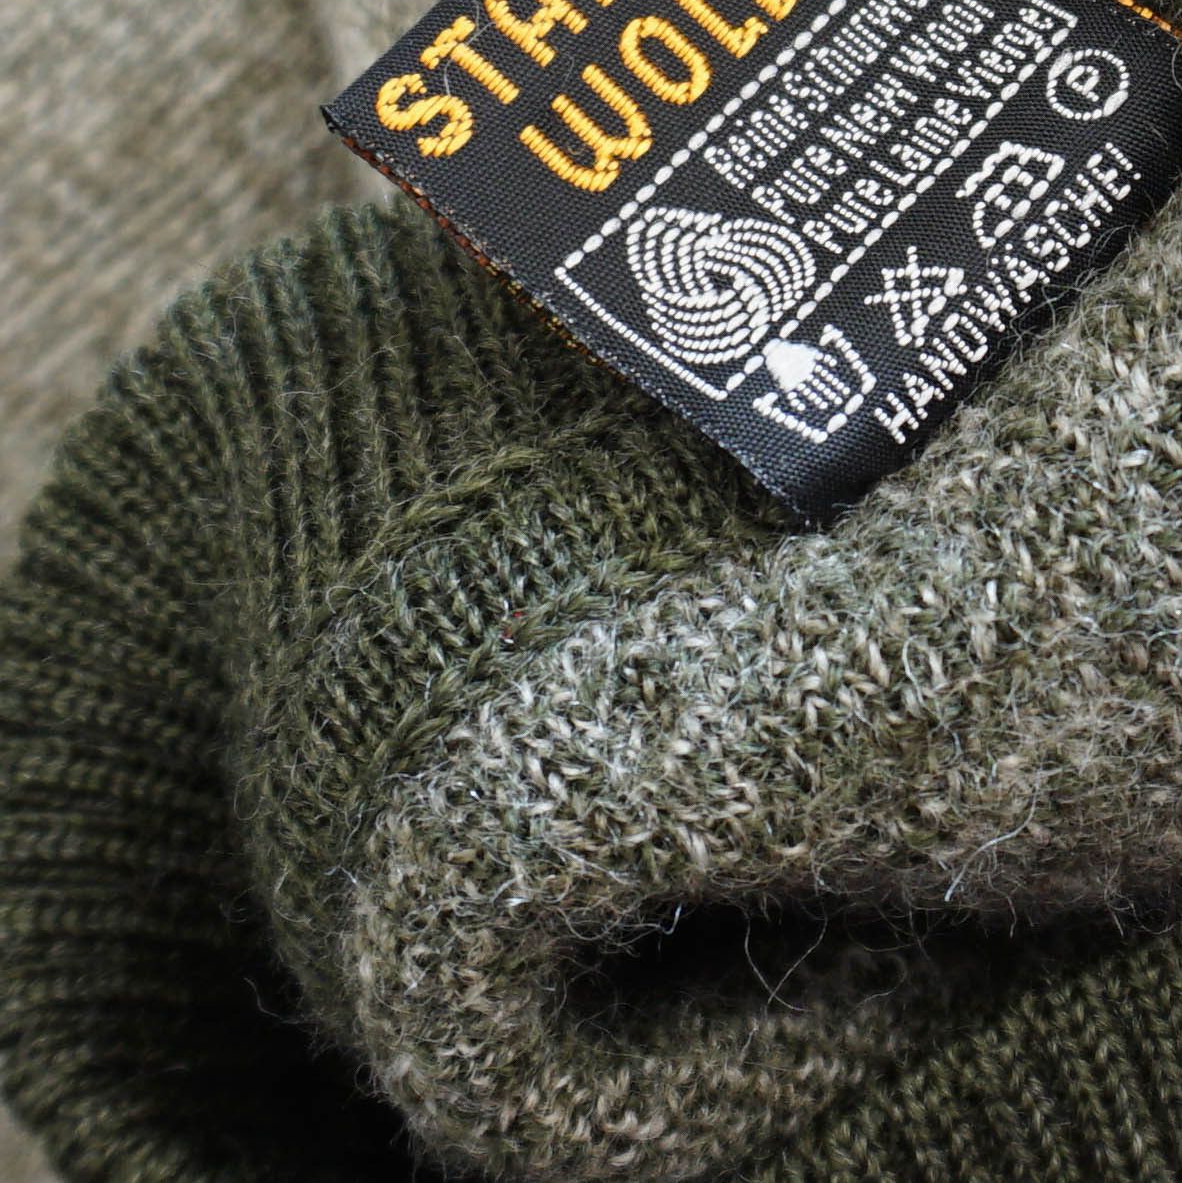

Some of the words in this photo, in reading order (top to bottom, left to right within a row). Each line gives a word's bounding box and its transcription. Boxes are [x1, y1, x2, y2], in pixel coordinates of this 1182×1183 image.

[704, 95, 808, 189] Reine
[751, 145, 848, 225] Pure
[820, 73, 918, 158] New
[802, 178, 894, 254] Pure
[870, 98, 973, 187] Laine
[945, 8, 1054, 99] Vierge
[874, 142, 1142, 445] HANDWÄSCHE!
